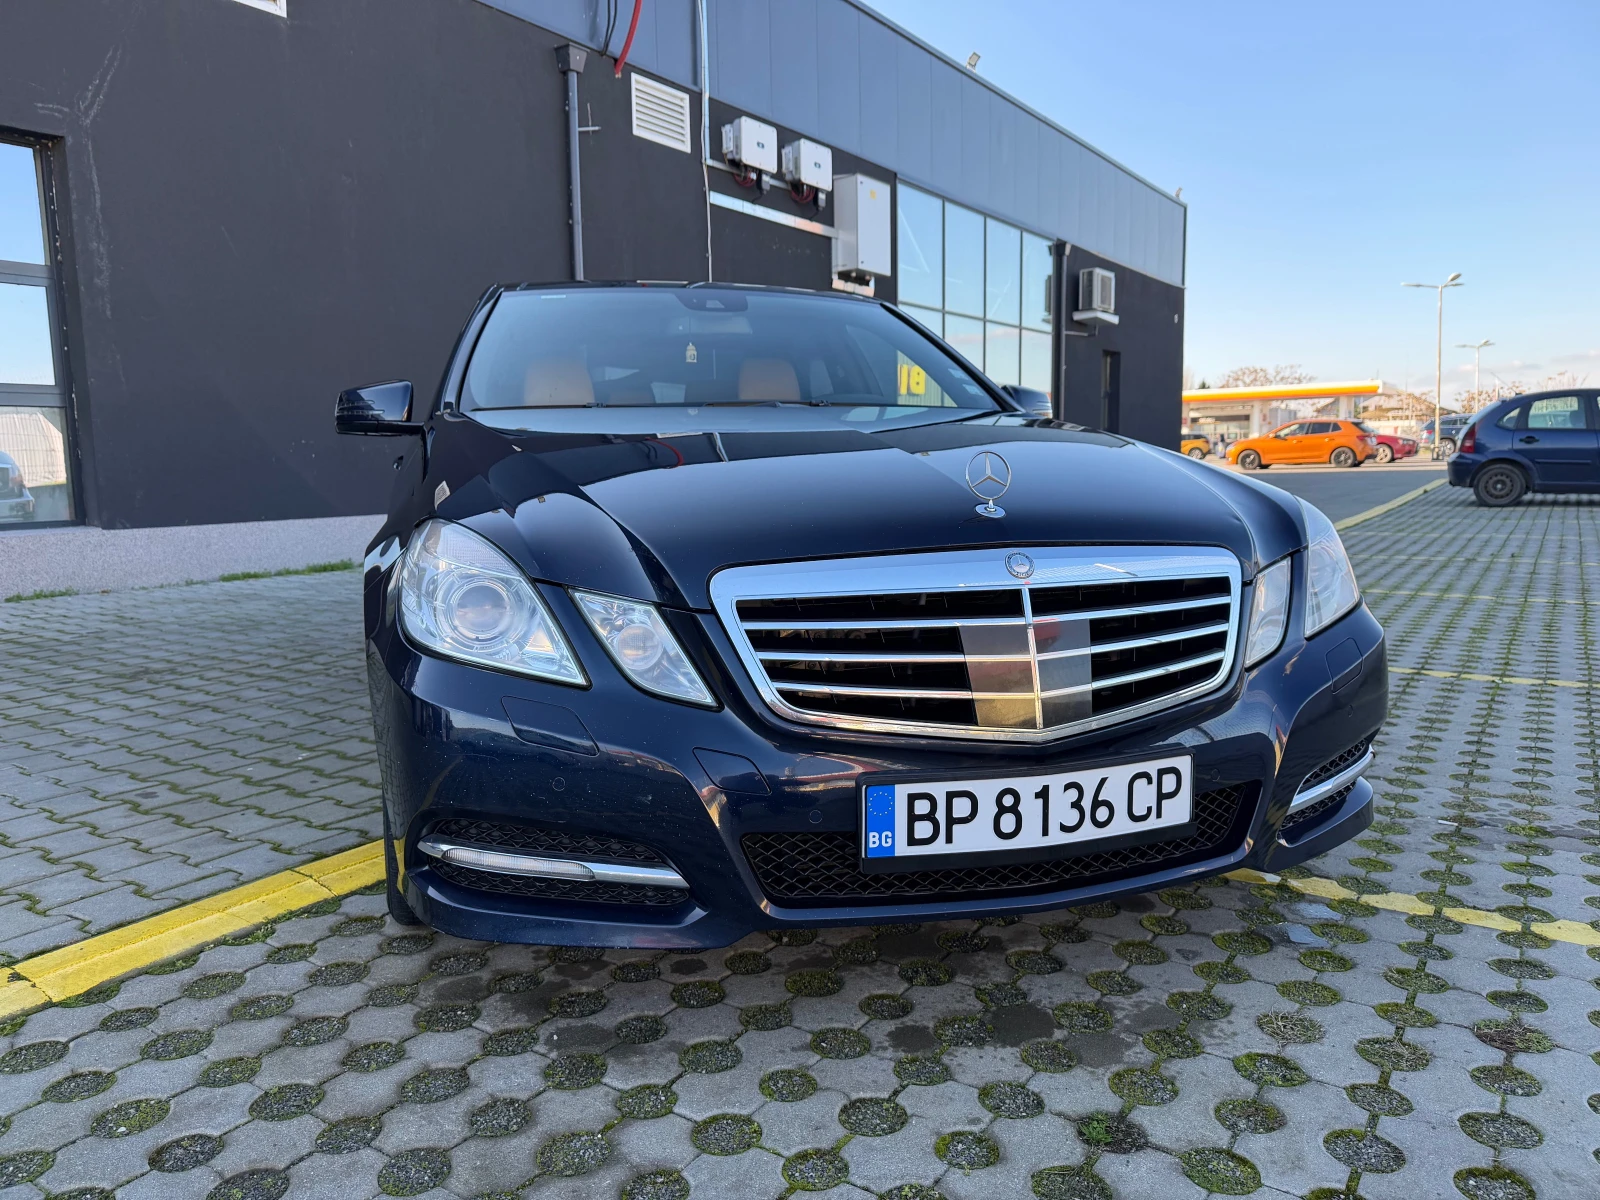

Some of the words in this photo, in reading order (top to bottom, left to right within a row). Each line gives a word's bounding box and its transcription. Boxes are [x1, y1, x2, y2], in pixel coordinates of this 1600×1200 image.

[906, 789, 979, 847] BP
[992, 776, 1116, 840] 8136
[1126, 766, 1183, 823] CP
[868, 831, 892, 848] BG
